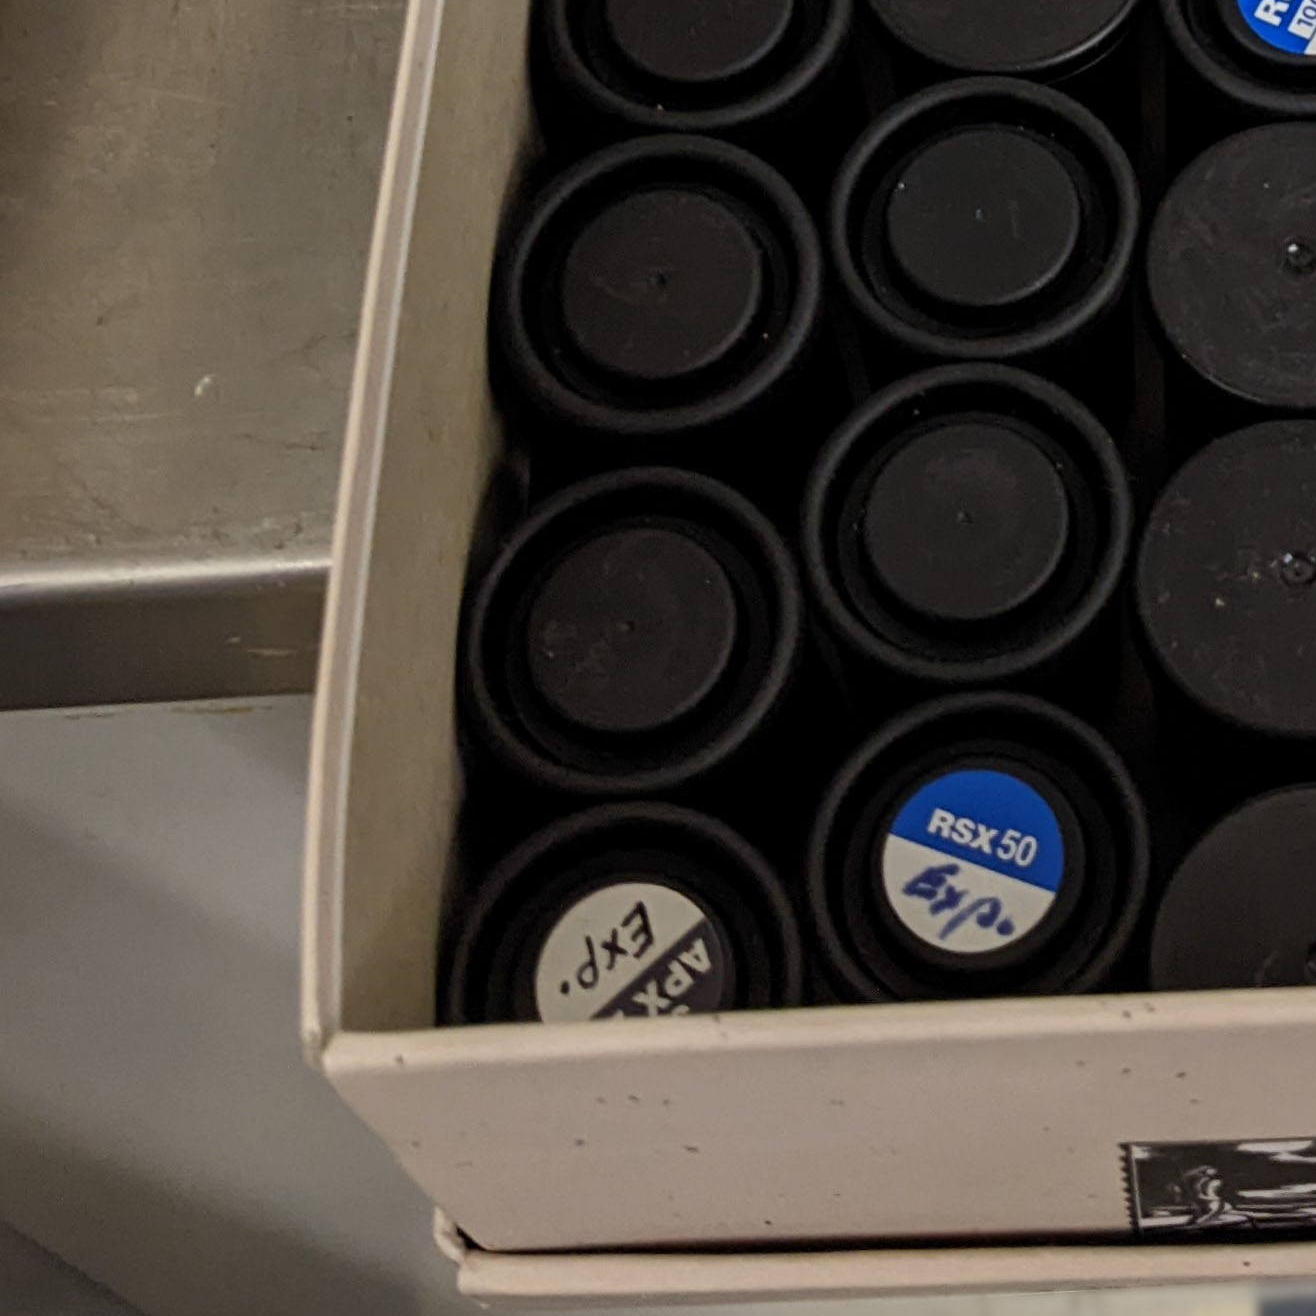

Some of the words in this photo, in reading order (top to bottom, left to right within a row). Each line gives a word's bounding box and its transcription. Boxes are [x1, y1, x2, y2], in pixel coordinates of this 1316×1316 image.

[926, 807, 998, 855] RSX
[996, 829, 1039, 868] 50
[631, 938, 712, 1016] APX
